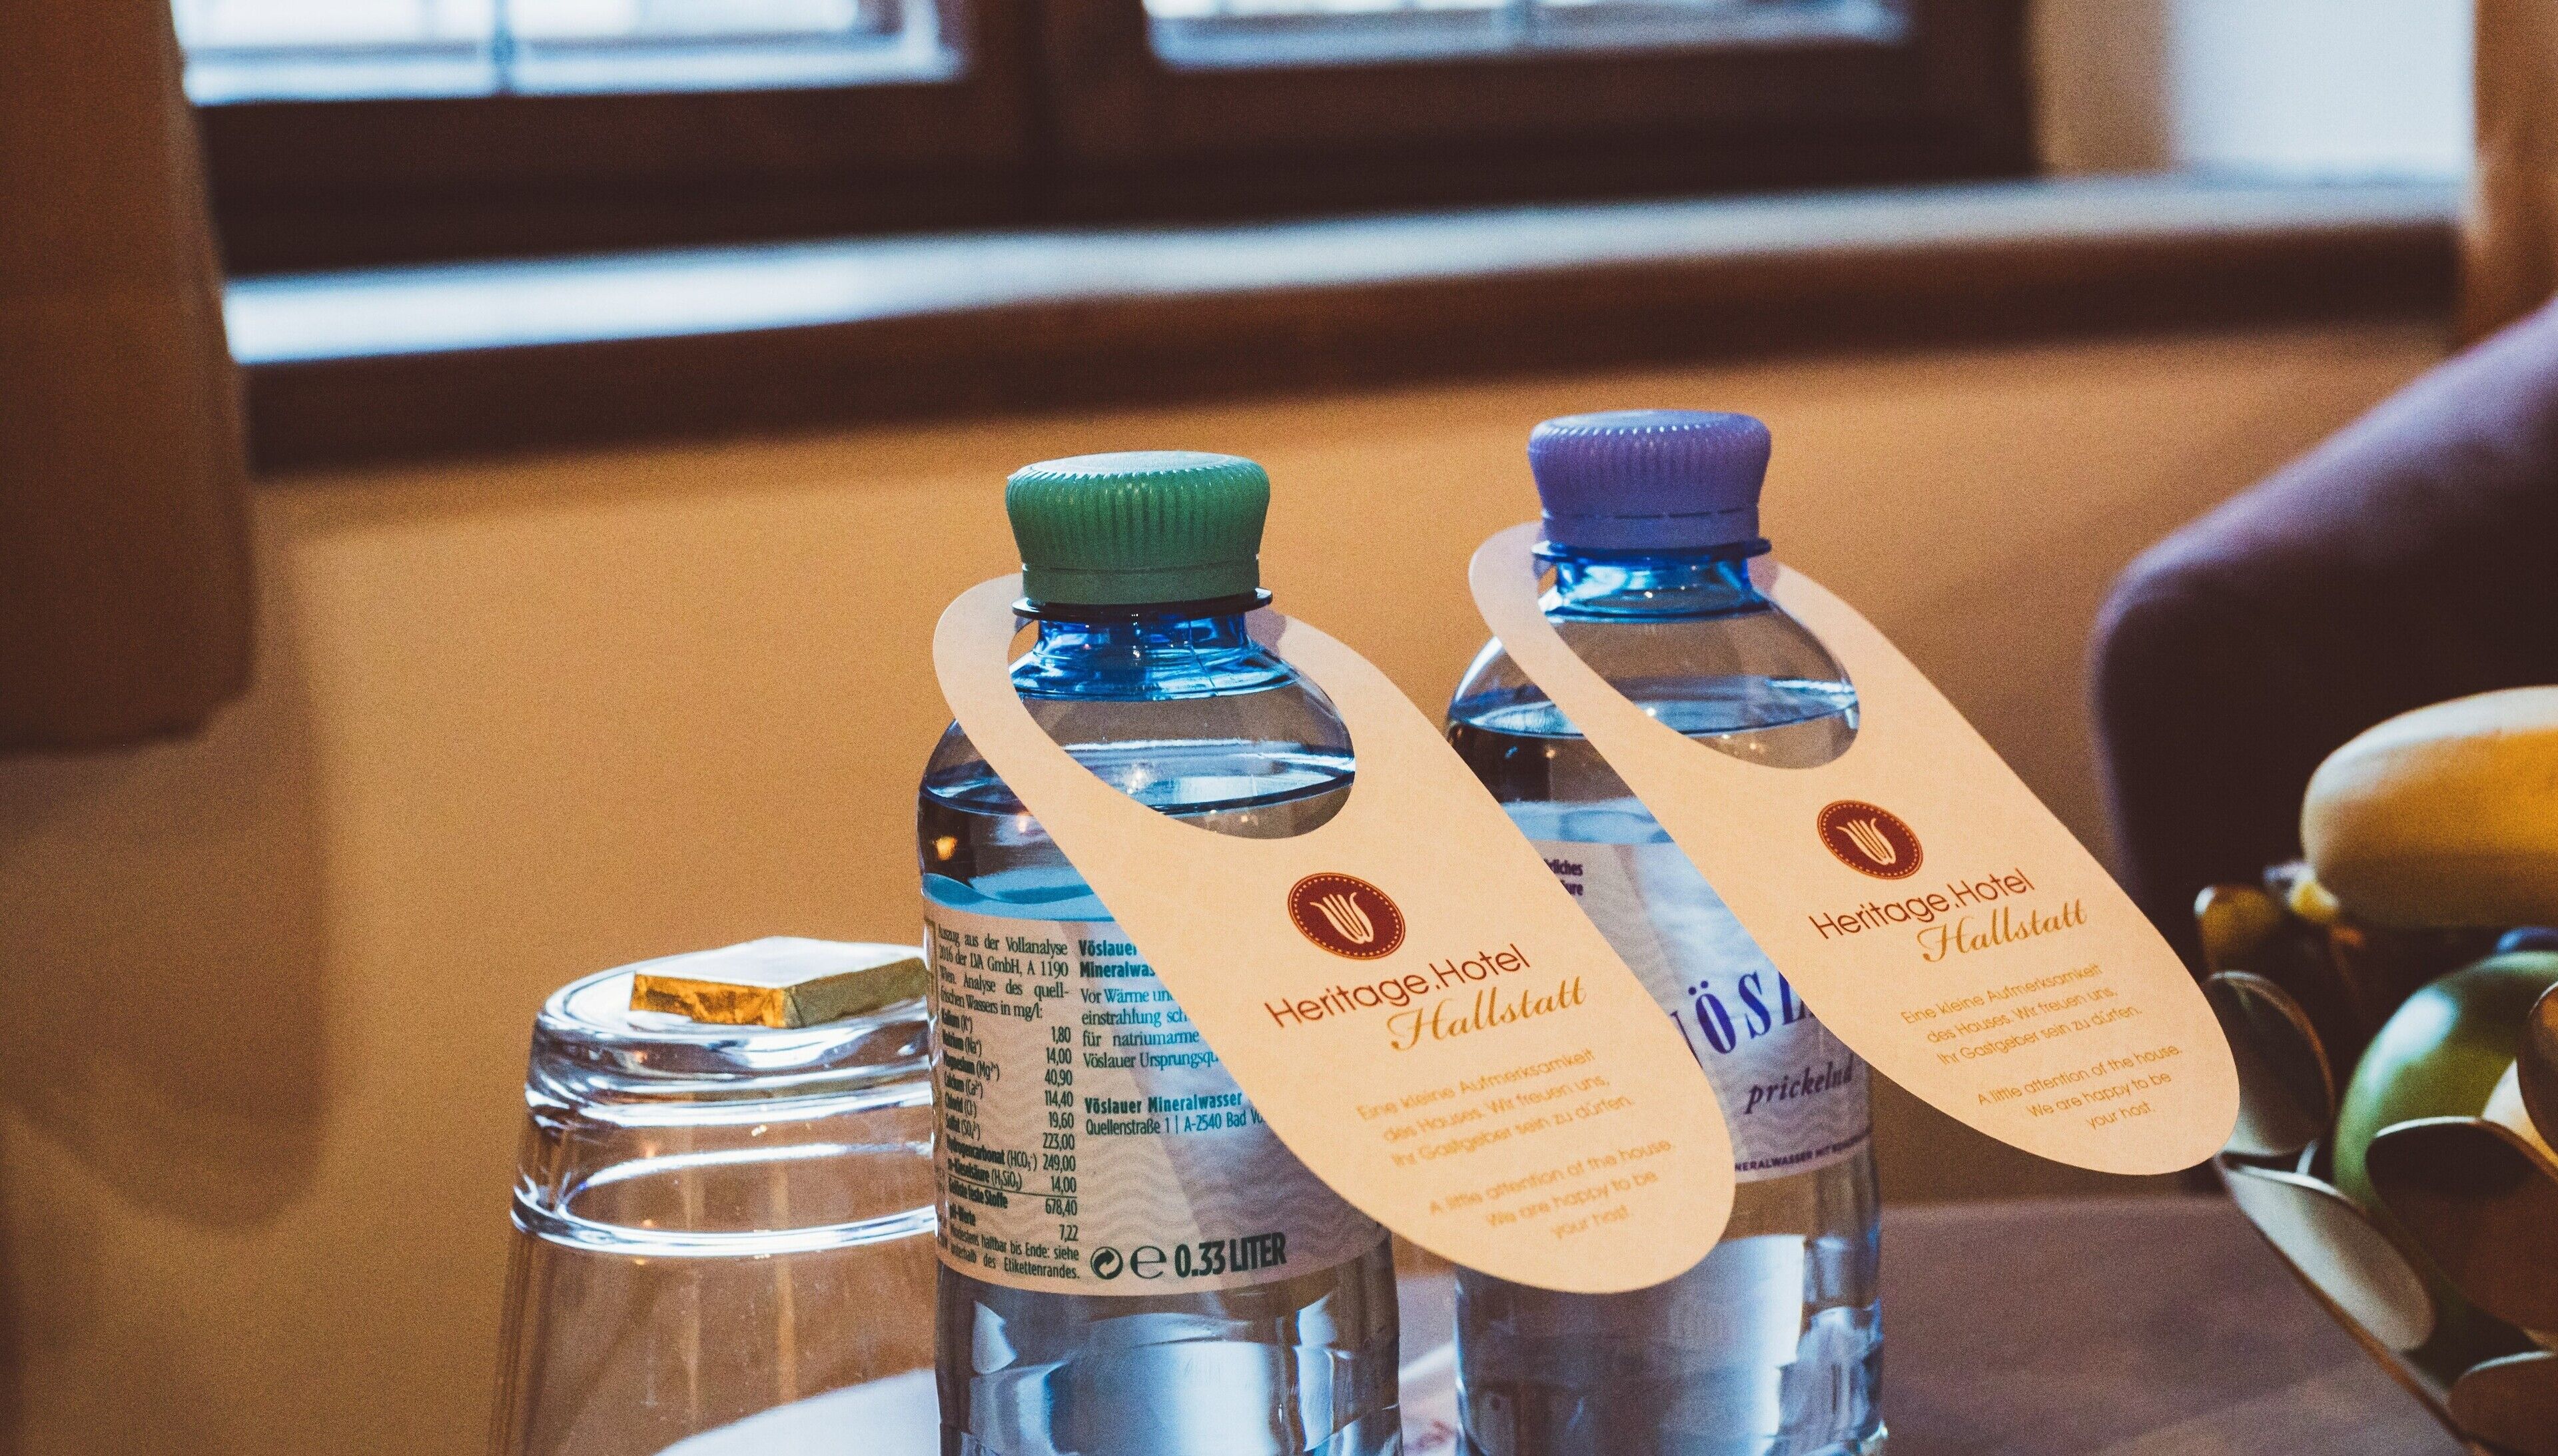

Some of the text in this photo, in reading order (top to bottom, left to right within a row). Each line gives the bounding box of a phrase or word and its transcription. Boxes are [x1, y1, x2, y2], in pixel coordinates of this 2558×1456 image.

[1809, 867, 2035, 940] Heritage.Hotel
[1917, 899, 2087, 962] Hallstatt
[965, 934, 979, 946] aus
[984, 933, 999, 950] der
[1006, 936, 1068, 958] Vollanalyse
[955, 948, 967, 965] der
[987, 956, 1023, 977] GmbH,
[1027, 962, 1035, 976] A
[1041, 961, 1068, 978] 1190
[964, 974, 996, 995] Analyse
[1005, 978, 1023, 996] des
[1035, 982, 1069, 1001] quell-
[1080, 988, 1102, 1004] Vor
[1104, 988, 1149, 1003] Wärme
[1264, 943, 1530, 1028] Heritage.Hotel
[1901, 962, 2102, 1025] Eine kleine Aufmerksamkeit
[966, 994, 999, 1014] Wassers
[1001, 1002, 1011, 1016] in
[1014, 1002, 1043, 1022] mg/l:
[1082, 1008, 1162, 1028] einstrahlung
[1387, 976, 1587, 1052] Hallstatt
[1927, 1026, 1955, 1043] des
[2012, 1004, 2036, 1020] Wir
[2038, 992, 2085, 1013] freuen
[1051, 1026, 1070, 1044] 1,80
[1082, 1031, 1199, 1047] für natriumarme
[1936, 1002, 2142, 1065] Ihr Gastgeber sein zu dürfen.
[1047, 1047, 1072, 1064] 14,00
[1083, 1052, 1136, 1069] Vöslauer
[1045, 1069, 1072, 1087] 40,90
[1356, 1048, 1595, 1121] Eine kleine Aufmerksamkeit
[1743, 1052, 1854, 1114] prickelnd
[1977, 1044, 2182, 1106] A little attention of the house.
[1045, 1090, 1074, 1108] 114,40
[1084, 1092, 1242, 1114] Vöslauer Mineralwasser
[2026, 1069, 2172, 1118] We are happy to be
[1049, 1112, 1074, 1129] 19,60
[1086, 1118, 1160, 1135] Quellenstraße
[1184, 1113, 1222, 1133] A-2540
[1226, 1110, 1246, 1128] Bad
[1384, 1125, 1417, 1143] des
[1486, 1098, 1514, 1116] Wir
[1516, 1084, 1572, 1106] freuen
[2086, 1111, 2118, 1130] your
[1043, 1133, 1075, 1150] 223,00
[1392, 1151, 1417, 1167] Ihr
[1418, 1128, 1511, 1161] Gastgeber
[1515, 1117, 1551, 1135] sein
[1555, 1112, 1573, 1126] zu
[1043, 1154, 1076, 1172] 249,00
[1051, 1176, 1076, 1193] 14,00
[1430, 1200, 1444, 1216] A
[1445, 1191, 1483, 1211] little
[1486, 1169, 1565, 1199] attention
[1567, 1160, 1585, 1177] of
[1587, 1154, 1617, 1172] the
[985, 1190, 1009, 1209] Stoffe
[1045, 1198, 1077, 1216] 678,40
[1486, 1170, 1659, 1228] We are happy to be
[1059, 1224, 1078, 1242] 7,22
[1551, 1222, 1589, 1240] your
[981, 1234, 1007, 1254] haltbar
[1010, 1240, 1023, 1255] bis
[1025, 1242, 1050, 1259] Ende:
[1054, 1245, 1079, 1261] siehe
[1175, 1240, 1226, 1277] 0.33
[1230, 1232, 1287, 1272] LITER
[983, 1254, 996, 1269] des
[1004, 1258, 1080, 1279] Etikettenrandes.
